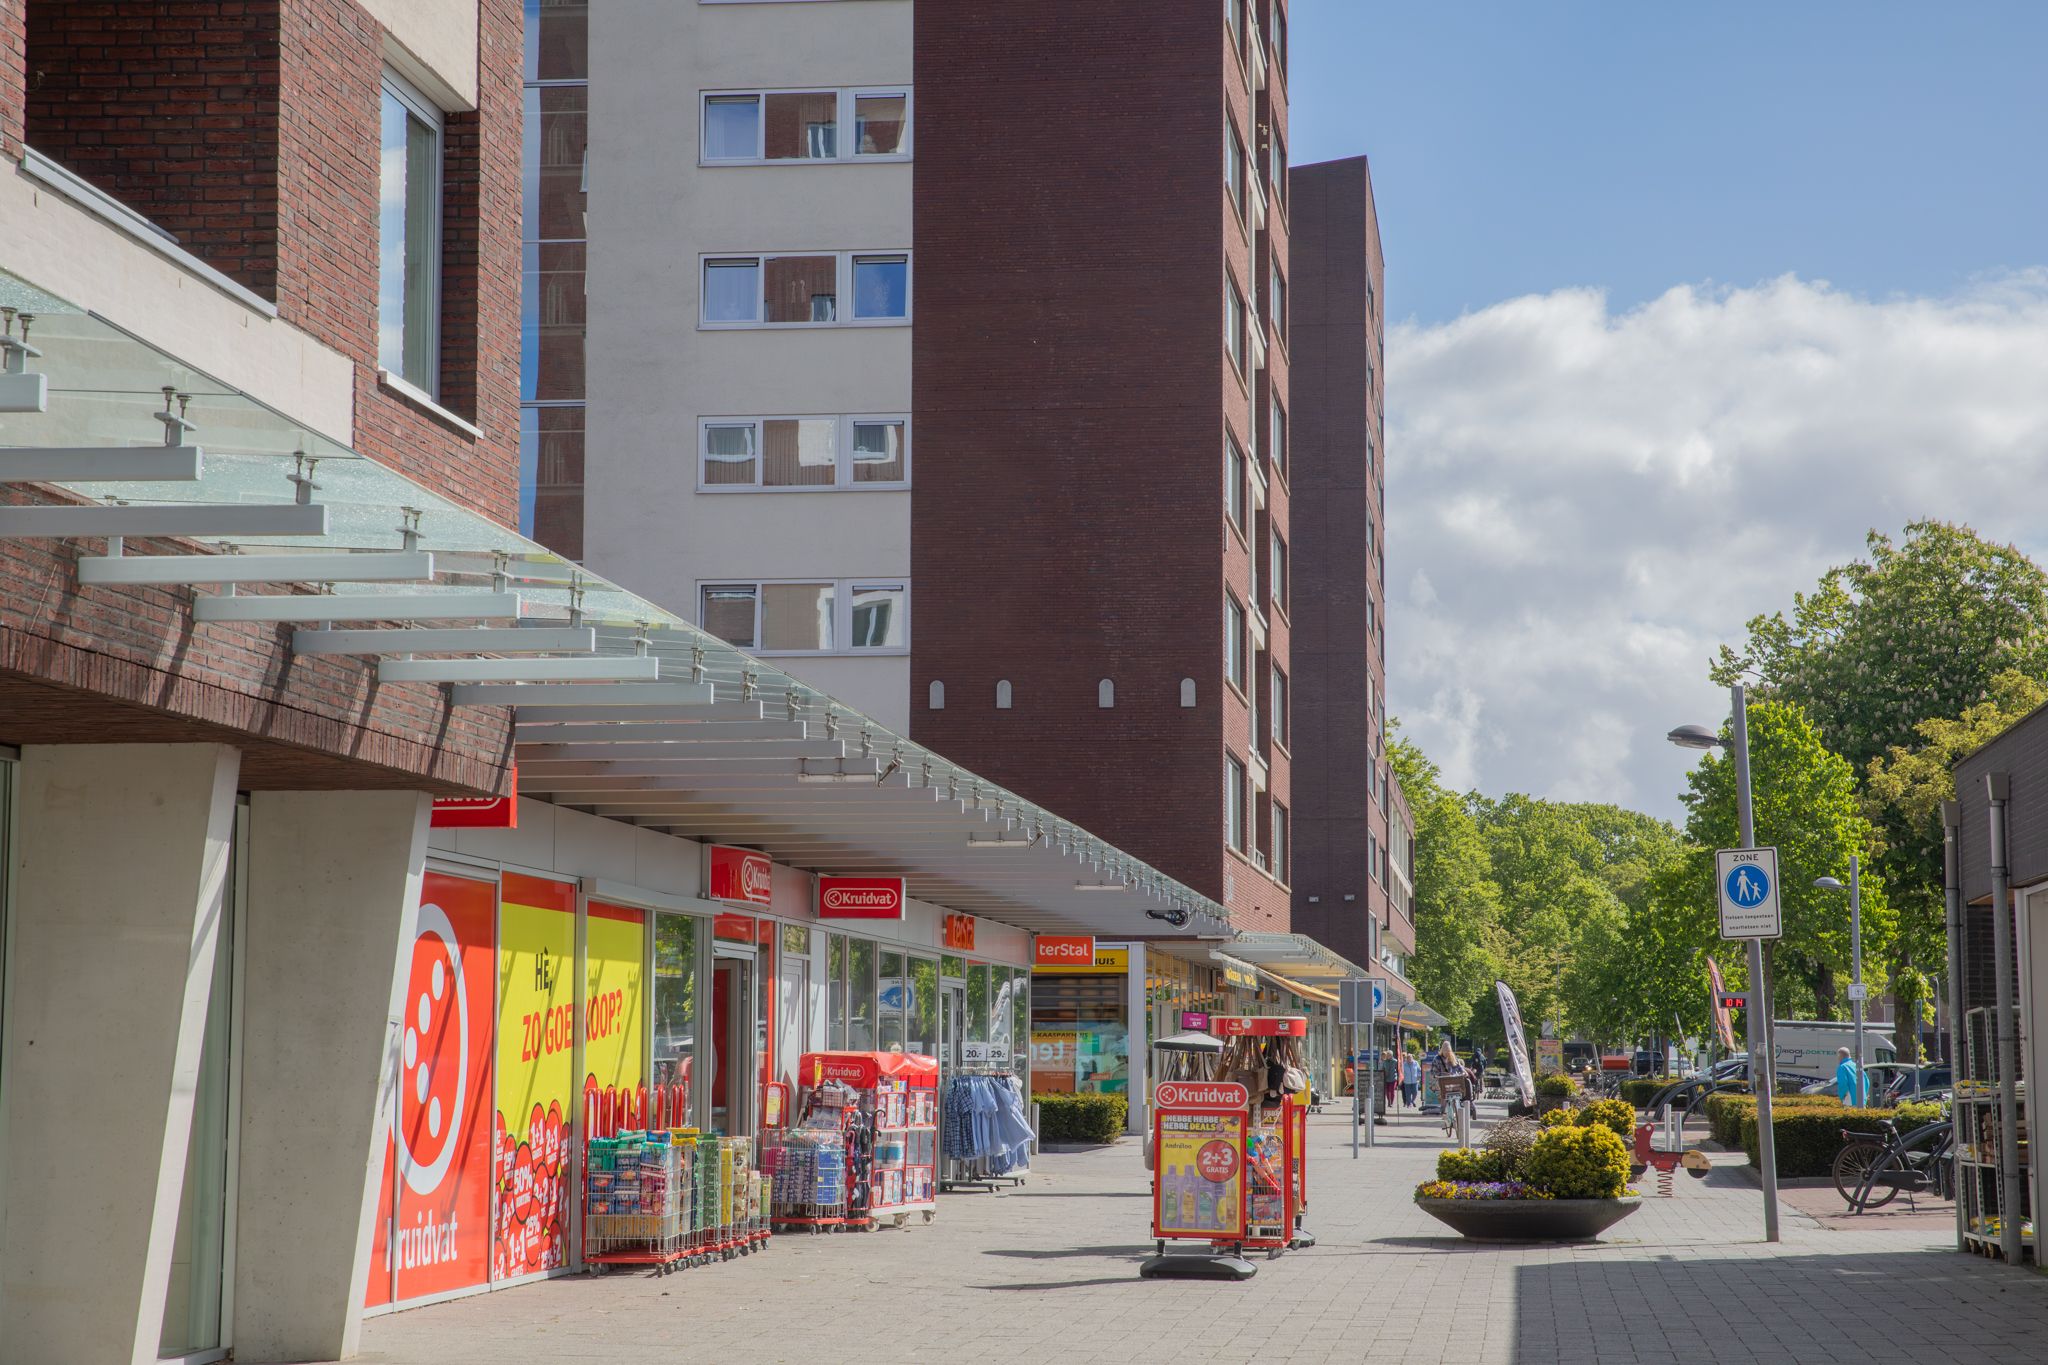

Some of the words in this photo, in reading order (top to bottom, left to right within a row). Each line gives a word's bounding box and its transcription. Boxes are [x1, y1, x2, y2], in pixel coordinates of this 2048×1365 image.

[1733, 854, 1759, 862] ZONE
[842, 892, 892, 905] Kruidvat
[1039, 943, 1089, 957] terStal
[522, 1011, 541, 1063] ZO
[827, 1067, 861, 1078] Kruidvat
[1178, 1087, 1241, 1103] Kruidvat
[1166, 1115, 1192, 1123] HEBBE
[1193, 1115, 1219, 1124] HEBBE
[1163, 1122, 1189, 1130] HEBBE
[1189, 1122, 1216, 1131] DEALS
[1202, 1147, 1233, 1166] 2+3
[1206, 1166, 1229, 1174] GRATIS
[514, 1163, 533, 1196] 50%
